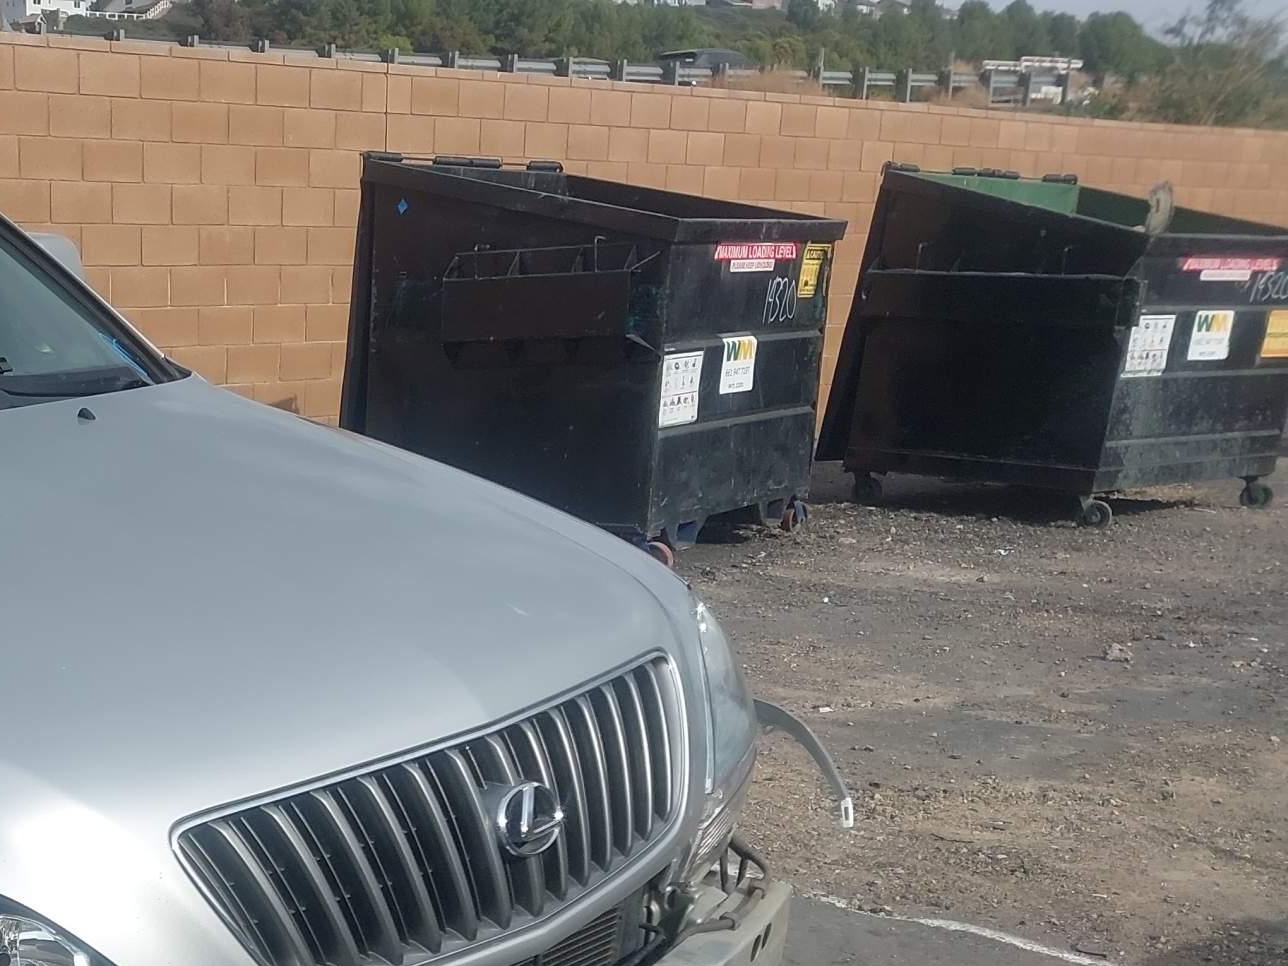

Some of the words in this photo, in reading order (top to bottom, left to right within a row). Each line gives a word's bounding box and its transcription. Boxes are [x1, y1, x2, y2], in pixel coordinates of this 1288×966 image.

[718, 245, 748, 258] MAXIMUM
[749, 245, 775, 258] LOADING
[775, 245, 793, 258] LEVEL
[726, 340, 754, 361] WM
